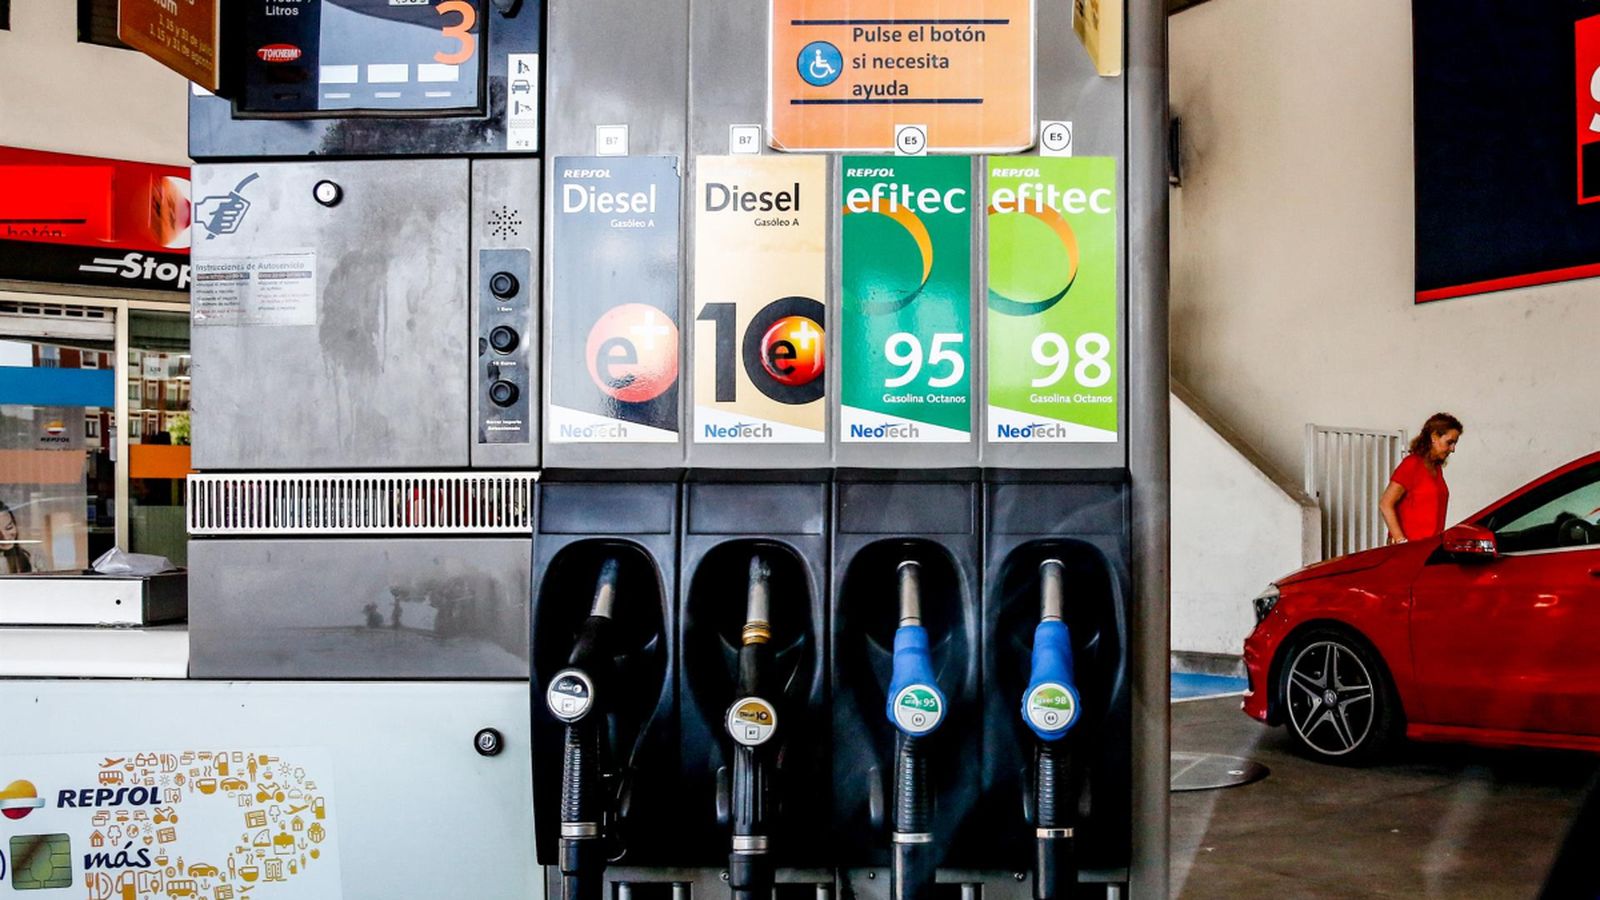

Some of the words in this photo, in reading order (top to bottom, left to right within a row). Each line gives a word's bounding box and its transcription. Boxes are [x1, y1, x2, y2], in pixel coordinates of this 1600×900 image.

[265, 6, 299, 16] Litros
[434, 1, 476, 65] 3
[853, 27, 902, 43] Pulse
[908, 26, 924, 43] el
[930, 26, 986, 43] botón
[852, 54, 866, 69] si
[873, 54, 949, 69] necesita
[852, 81, 909, 99] ayuda
[606, 137, 618, 145] B7
[739, 136, 751, 145] B7
[905, 136, 917, 145] E5
[1050, 133, 1063, 141] E5
[563, 169, 612, 178] REPSOL
[847, 168, 895, 177] REPSOL
[992, 168, 1041, 177] REPSOL
[563, 184, 656, 213] Diesel
[706, 182, 800, 212] Diesel
[846, 183, 967, 214] efitec
[992, 183, 1112, 214] efitec
[610, 218, 646, 228] Gasóleo
[647, 219, 655, 228] A
[754, 218, 790, 227] Gasóleo
[792, 218, 800, 226] A
[195, 263, 245, 271] Instrucciones
[246, 263, 255, 271] de
[257, 262, 305, 270] Autoservicio
[697, 296, 826, 405] 10
[884, 332, 965, 388] 95
[1031, 332, 1111, 388] 98
[883, 393, 924, 404] Gasolina
[926, 393, 966, 404] Octanos
[1030, 393, 1071, 404] Gasolina
[1074, 393, 1113, 404] Octanos
[560, 423, 627, 438] NeoTech
[705, 422, 773, 438] NeoTech
[850, 422, 919, 438] NeoTech
[997, 422, 1066, 438] NeoTech
[923, 697, 936, 707] 95
[1055, 696, 1067, 705] 98
[57, 786, 162, 808] REPSOL
[84, 841, 152, 870] más
